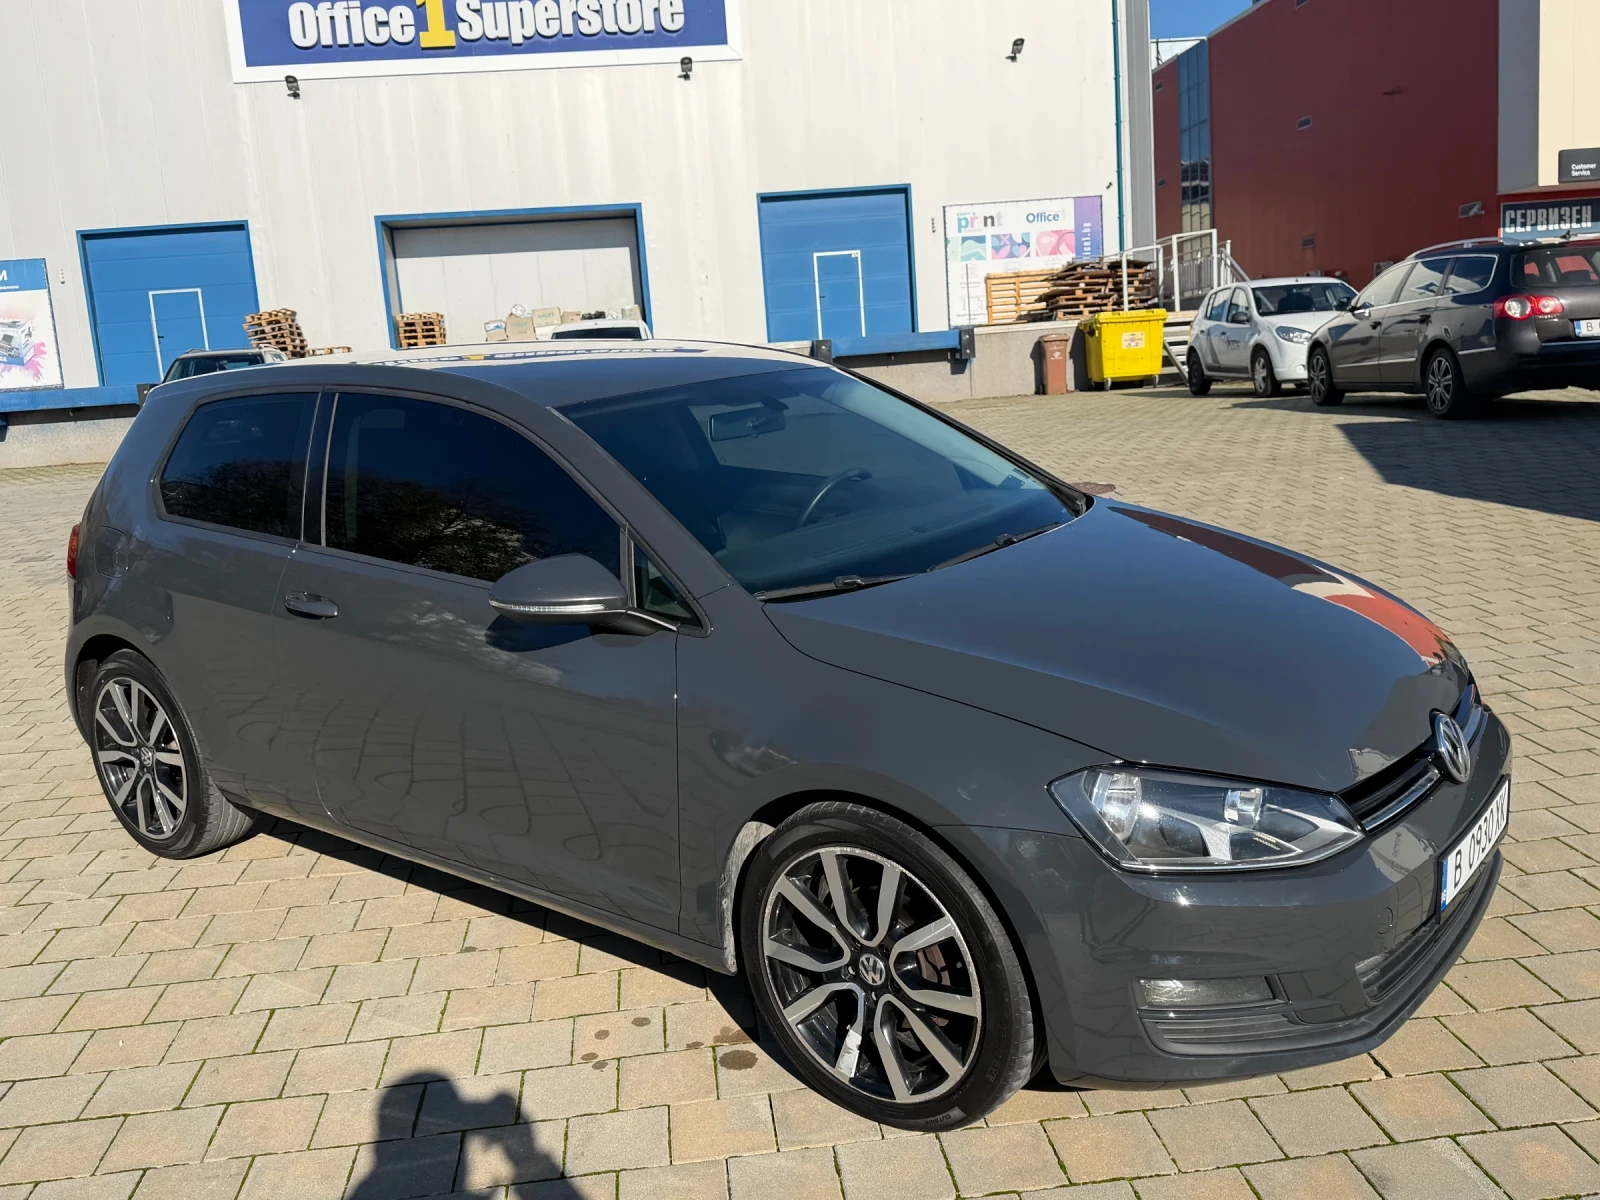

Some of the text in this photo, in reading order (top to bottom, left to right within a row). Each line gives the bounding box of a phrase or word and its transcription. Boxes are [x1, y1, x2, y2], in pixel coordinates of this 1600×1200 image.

[288, 1, 415, 49] Office
[456, 0, 684, 46] Superstore
[1571, 163, 1597, 171] Customer
[1571, 169, 1591, 177] Service
[1026, 211, 1060, 223] Office
[1505, 205, 1592, 233] СЕРВИЗЕН
[1453, 848, 1463, 890] B
[1468, 807, 1493, 871] 0930
